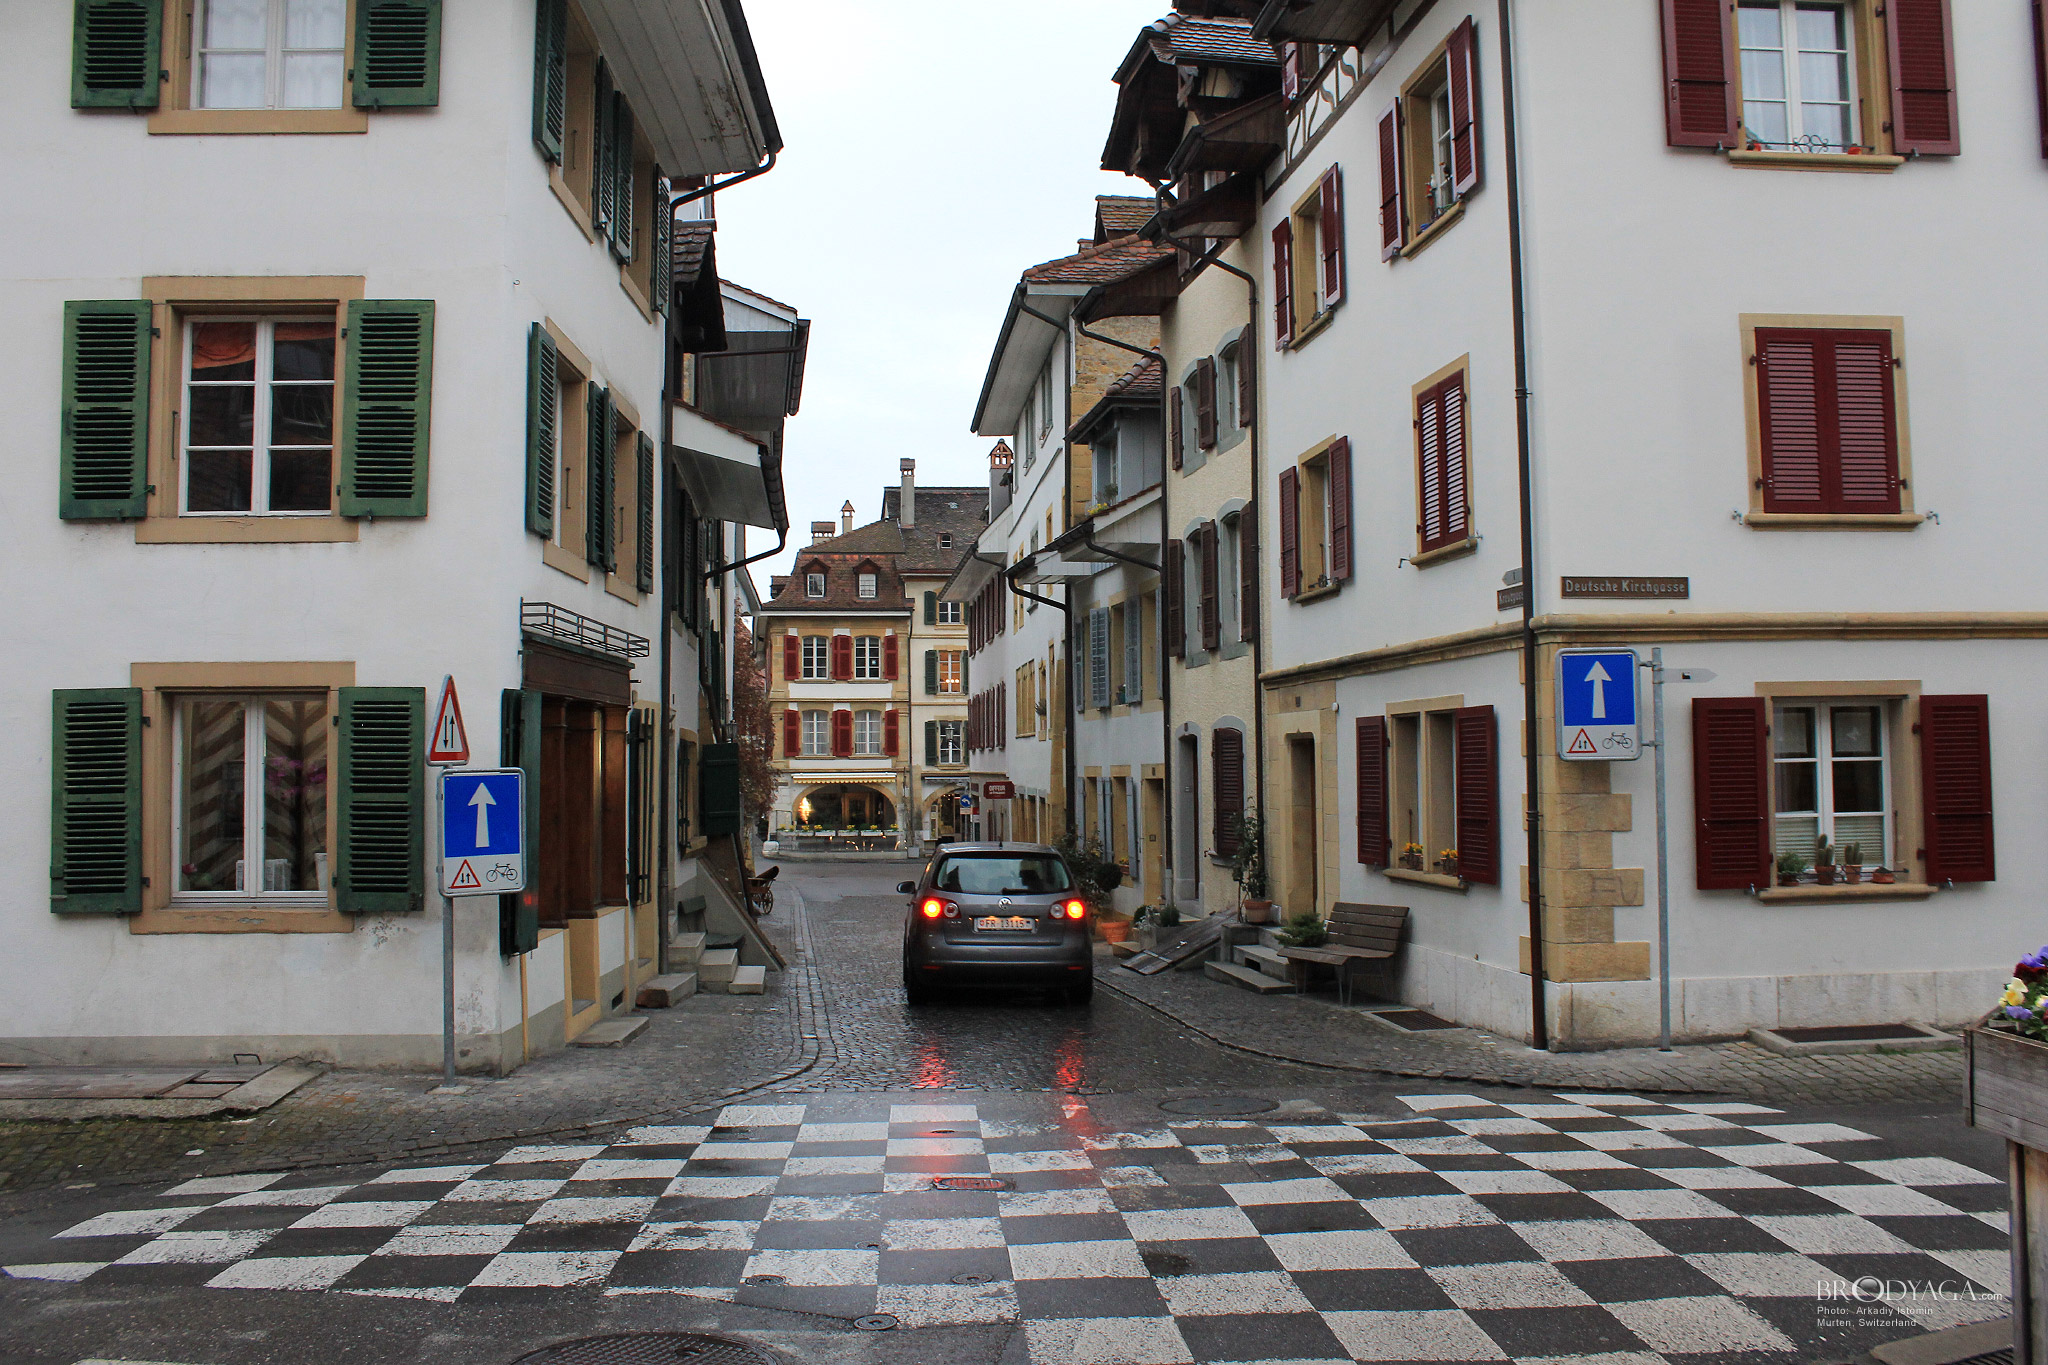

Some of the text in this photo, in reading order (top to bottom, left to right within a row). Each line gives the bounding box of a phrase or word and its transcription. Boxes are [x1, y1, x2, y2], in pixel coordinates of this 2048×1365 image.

[1565, 579, 1685, 595] Deutsche Kirchgasse
[985, 919, 996, 928] FR
